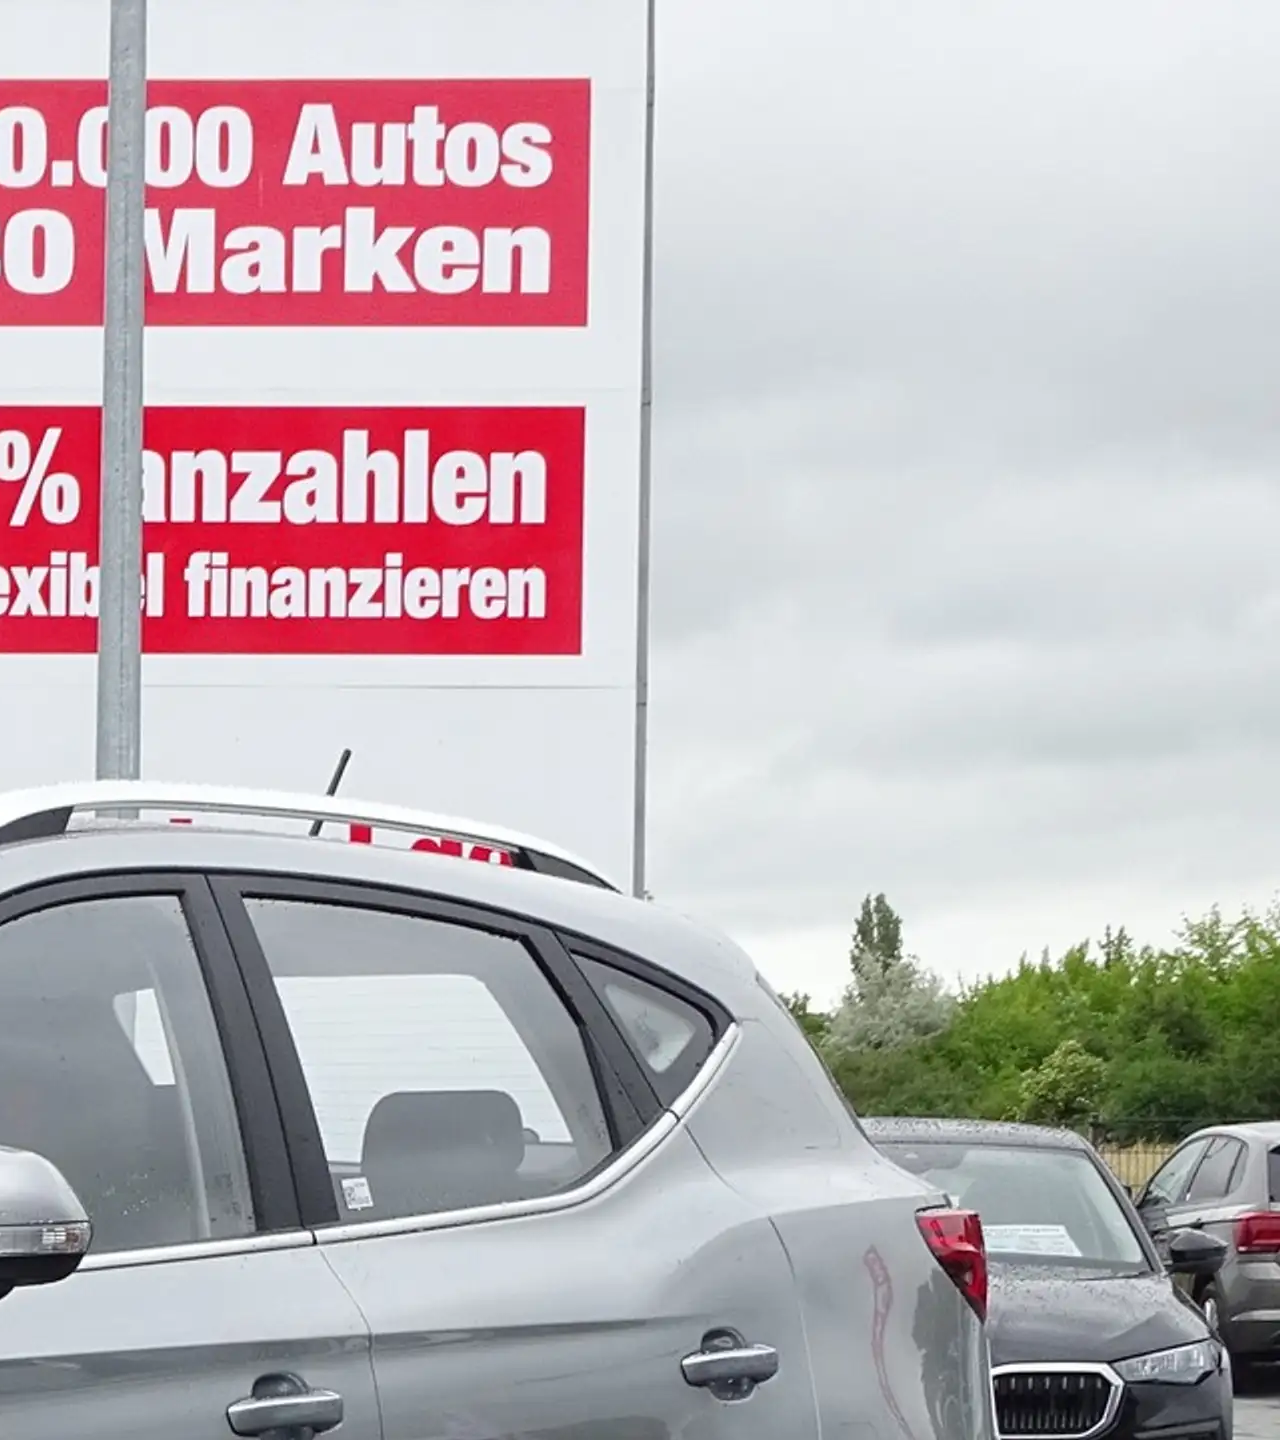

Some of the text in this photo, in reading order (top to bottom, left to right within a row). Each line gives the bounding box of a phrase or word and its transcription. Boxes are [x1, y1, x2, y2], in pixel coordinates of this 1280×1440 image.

[283, 103, 553, 188] Autos
[144, 207, 551, 294] Marken
[184, 551, 546, 619] finanzieren
